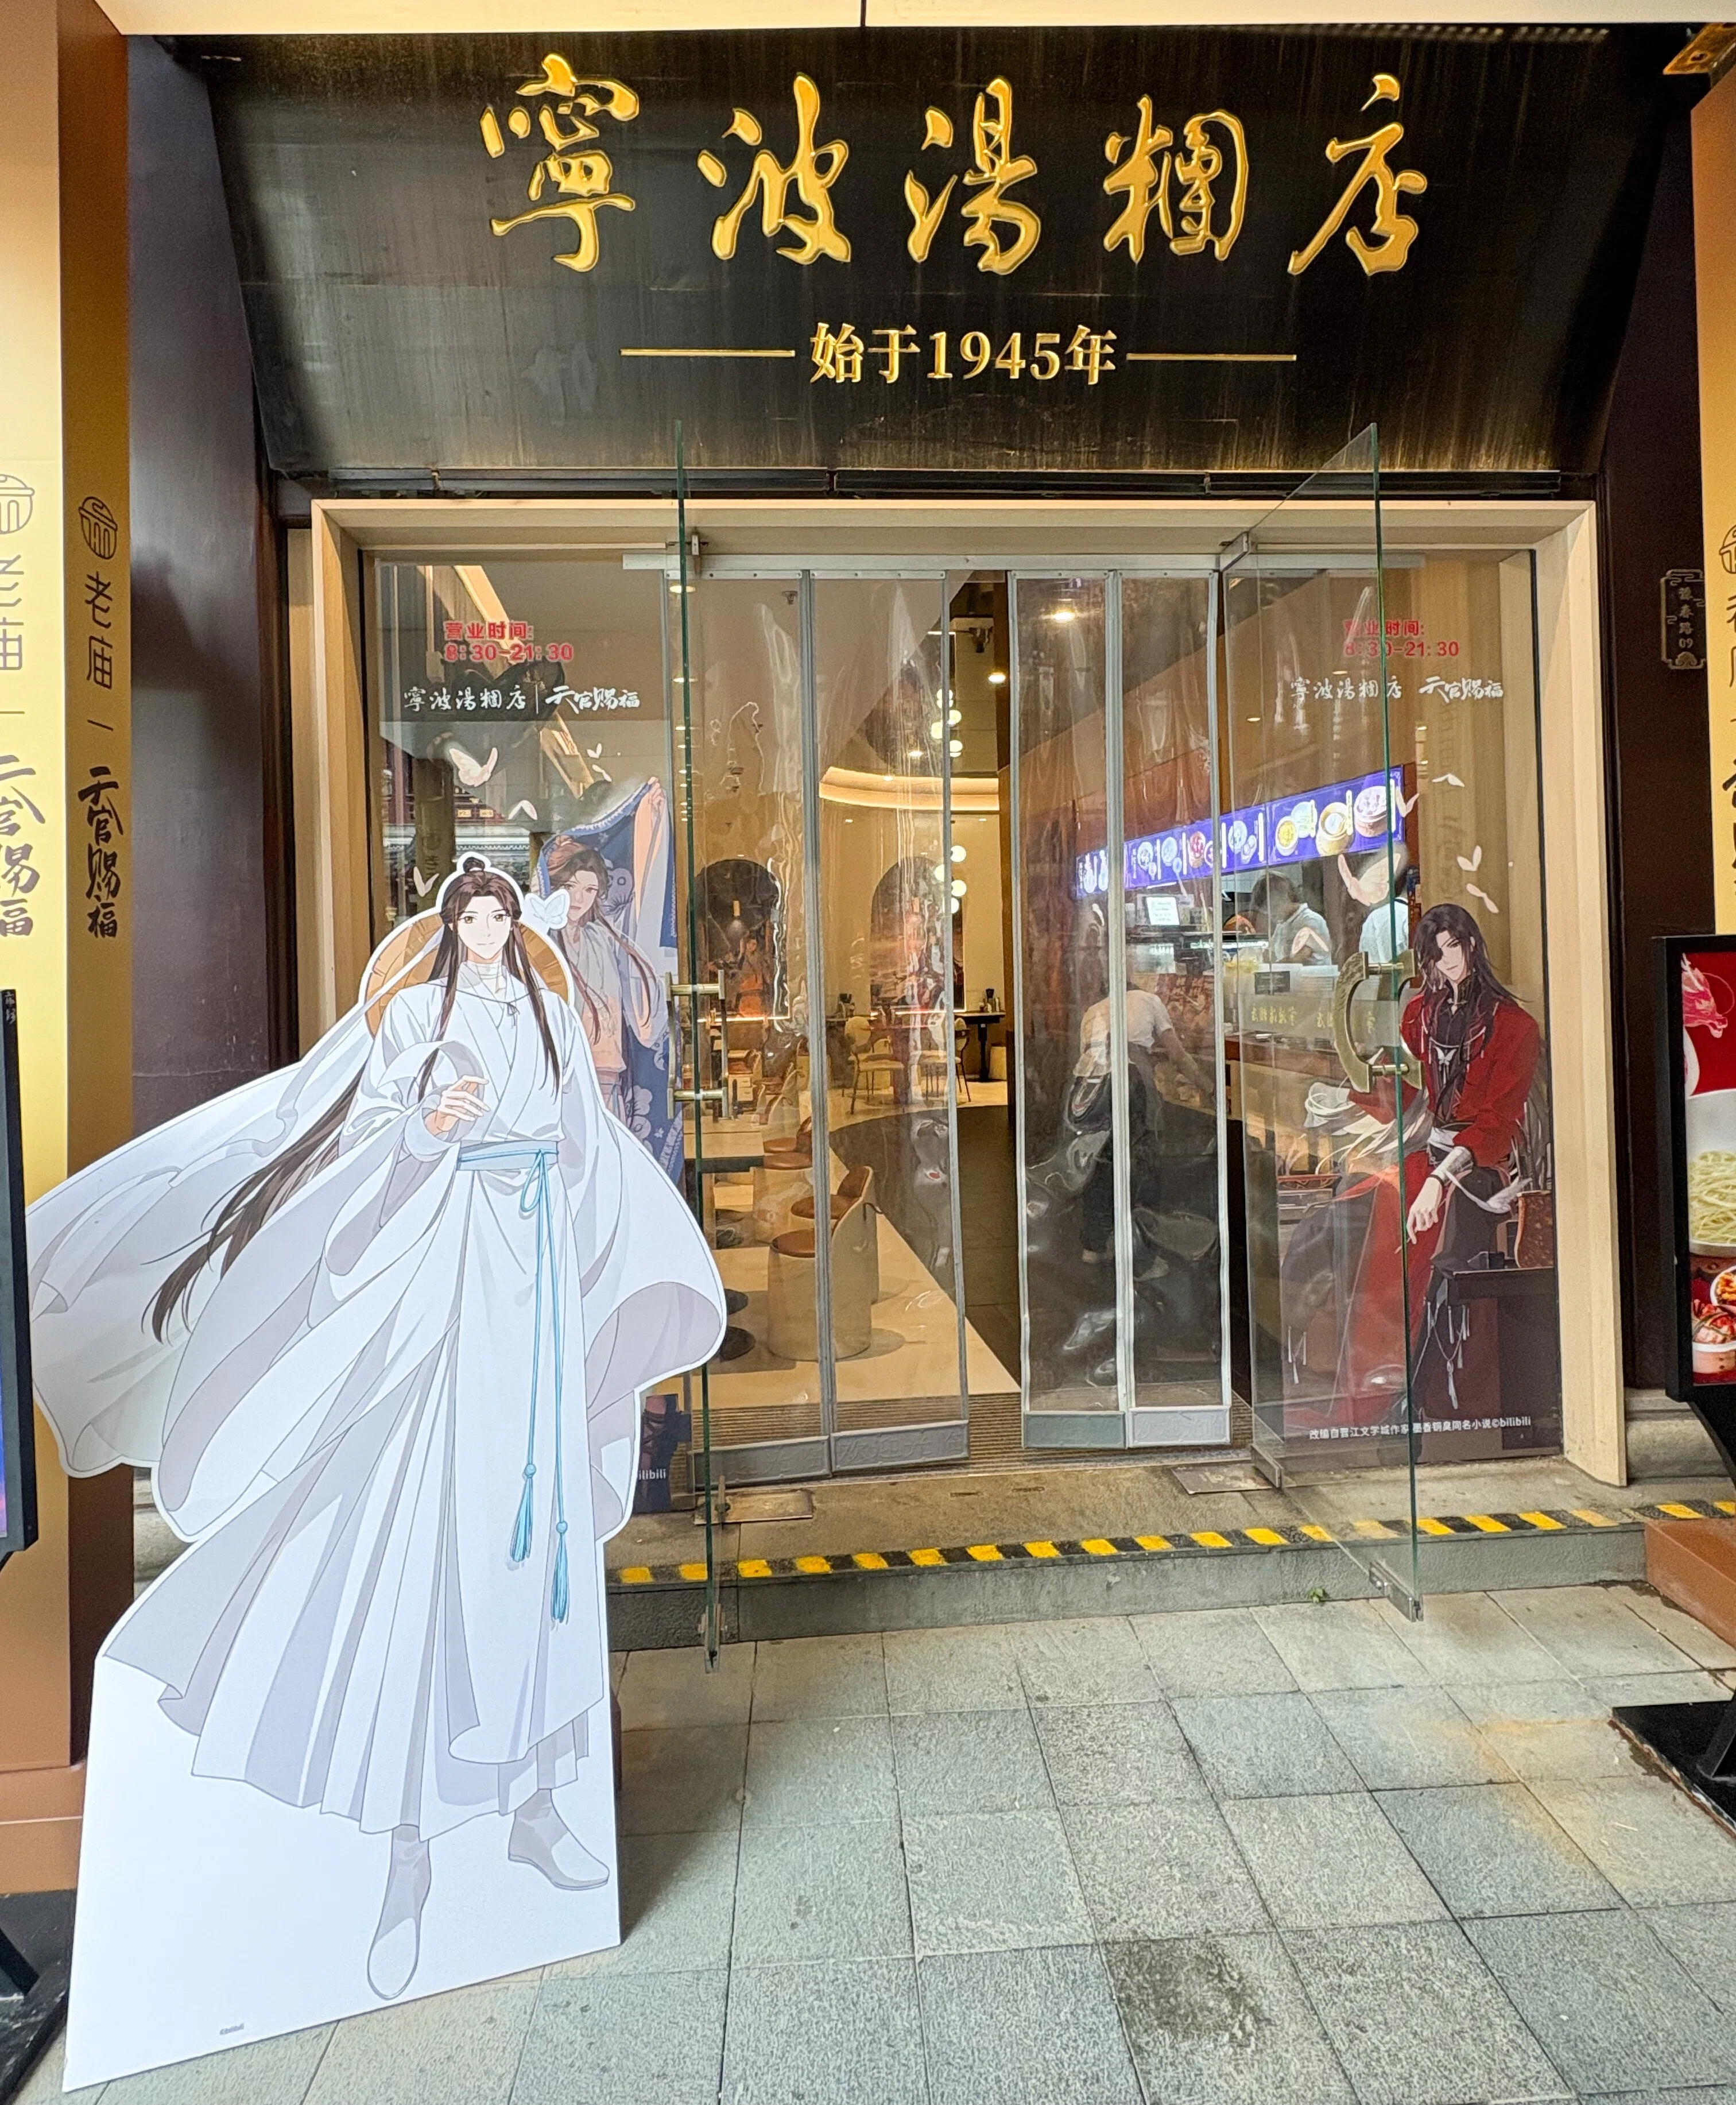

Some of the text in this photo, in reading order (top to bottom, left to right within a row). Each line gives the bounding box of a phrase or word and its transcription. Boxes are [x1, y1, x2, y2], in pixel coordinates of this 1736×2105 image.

[809, 323, 1116, 386] 始于1945年
[444, 621, 534, 641] 营业时间:
[444, 643, 574, 662] 8:30-21:30
[544, 684, 641, 714] 天官赐福
[1419, 676, 1504, 703] 天官赐福
[78, 571, 123, 939] 老庙 天官赐福
[637, 1468, 666, 1481] ilibili
